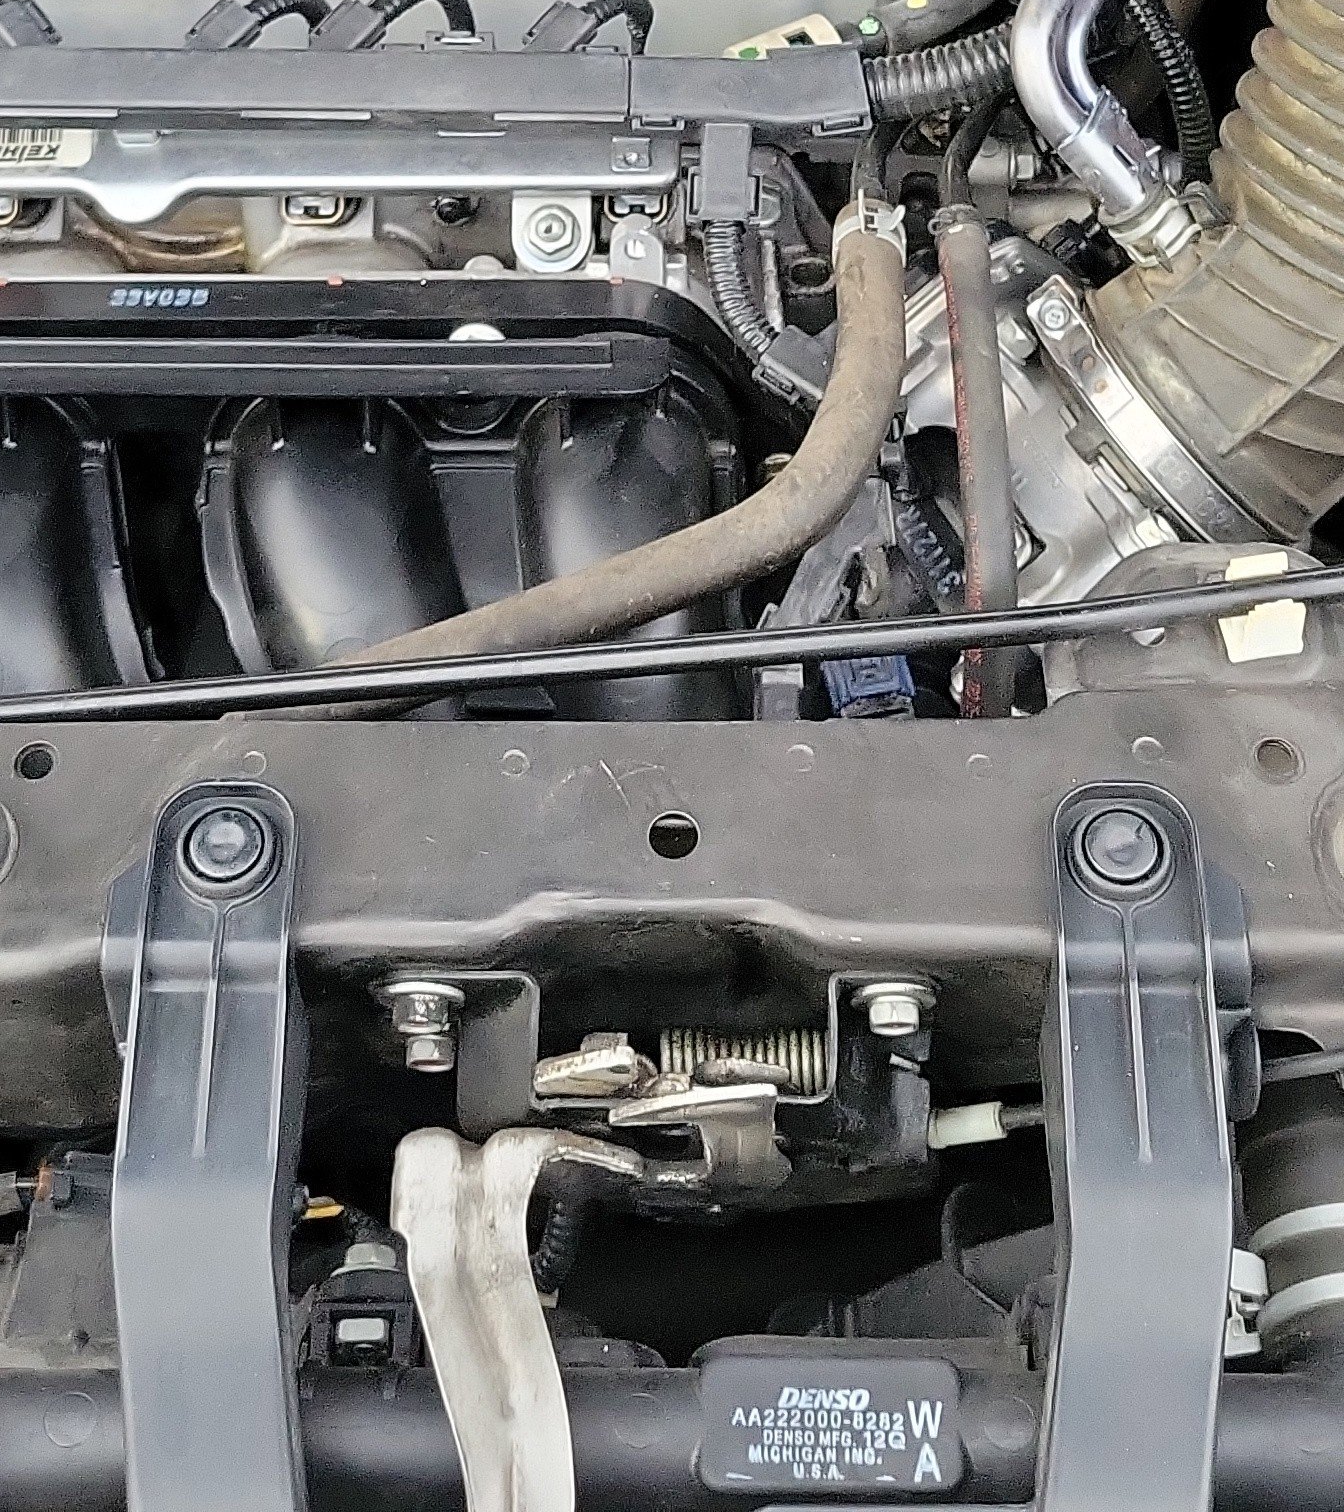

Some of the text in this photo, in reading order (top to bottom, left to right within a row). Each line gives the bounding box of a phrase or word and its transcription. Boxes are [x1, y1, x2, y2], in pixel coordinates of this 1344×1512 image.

[778, 1387, 871, 1411] DENSO
[731, 1407, 905, 1431] AA222000-8282
[907, 1400, 943, 1439] W
[763, 1430, 815, 1447] DENSO
[819, 1431, 856, 1448] MFG.
[748, 1443, 837, 1465] MICHIGAN
[913, 1441, 942, 1484] A
[792, 1463, 845, 1481] U.S.A.
